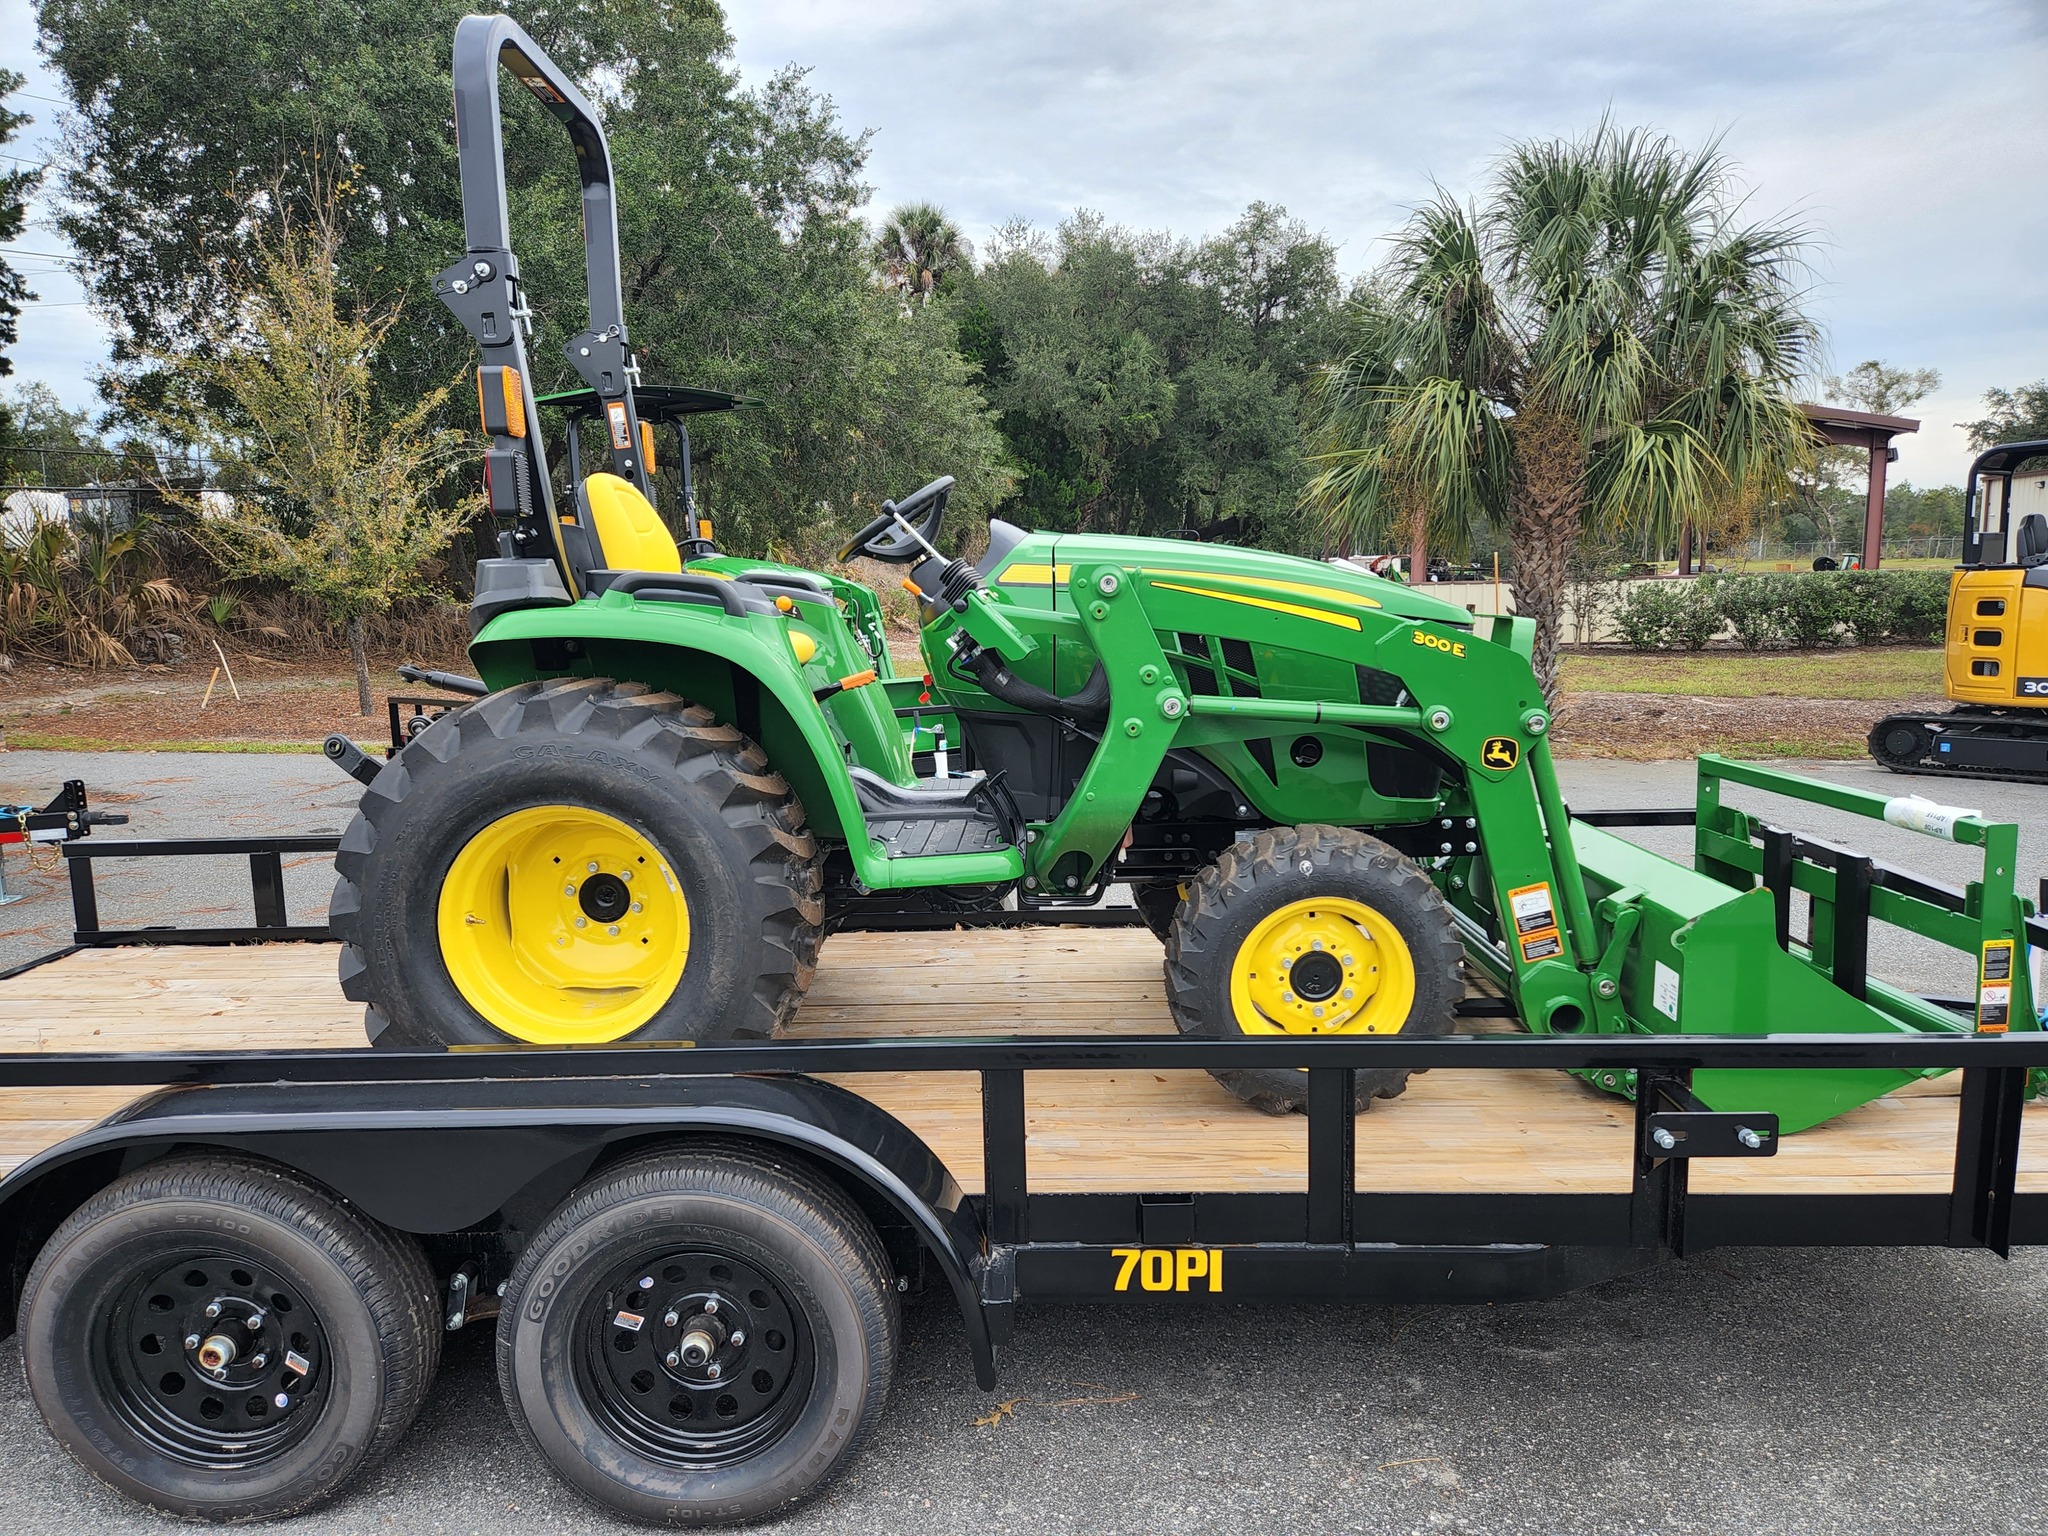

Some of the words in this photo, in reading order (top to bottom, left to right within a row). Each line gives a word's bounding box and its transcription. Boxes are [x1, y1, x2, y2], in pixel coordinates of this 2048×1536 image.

[513, 744, 661, 783] GALAXY
[174, 1213, 251, 1235] ST-100
[529, 1206, 674, 1320] GOODRIDE
[665, 1503, 742, 1518] ST-100
